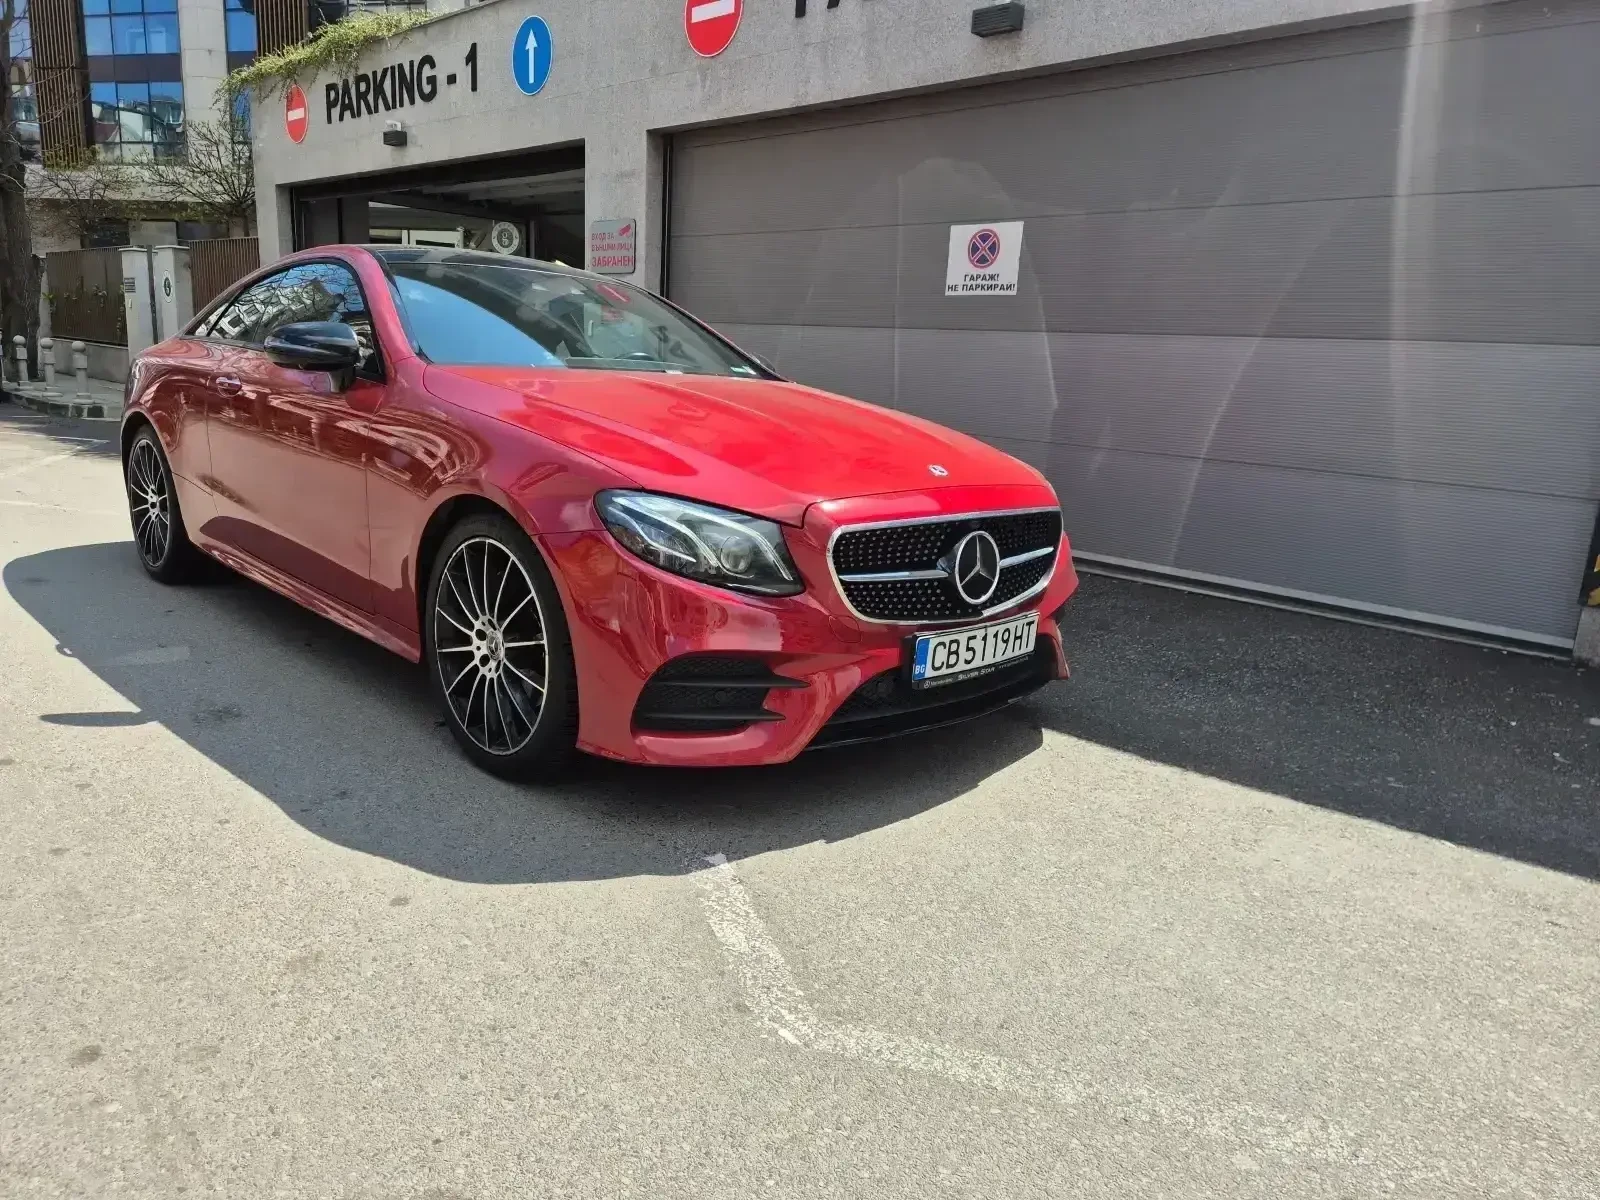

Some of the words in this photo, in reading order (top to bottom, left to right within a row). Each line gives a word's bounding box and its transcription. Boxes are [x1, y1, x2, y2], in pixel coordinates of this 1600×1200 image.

[325, 54, 438, 124] PARKING
[465, 42, 478, 92] 1
[591, 232, 606, 242] ВХОД
[607, 232, 615, 240] ЗА
[591, 255, 634, 267] ЗАБРАНЕН
[963, 273, 1000, 282] ГАРАЖ!
[947, 284, 959, 292] НЕ
[961, 281, 1016, 292] ПАРКИРАЙ!
[914, 664, 926, 674] BG
